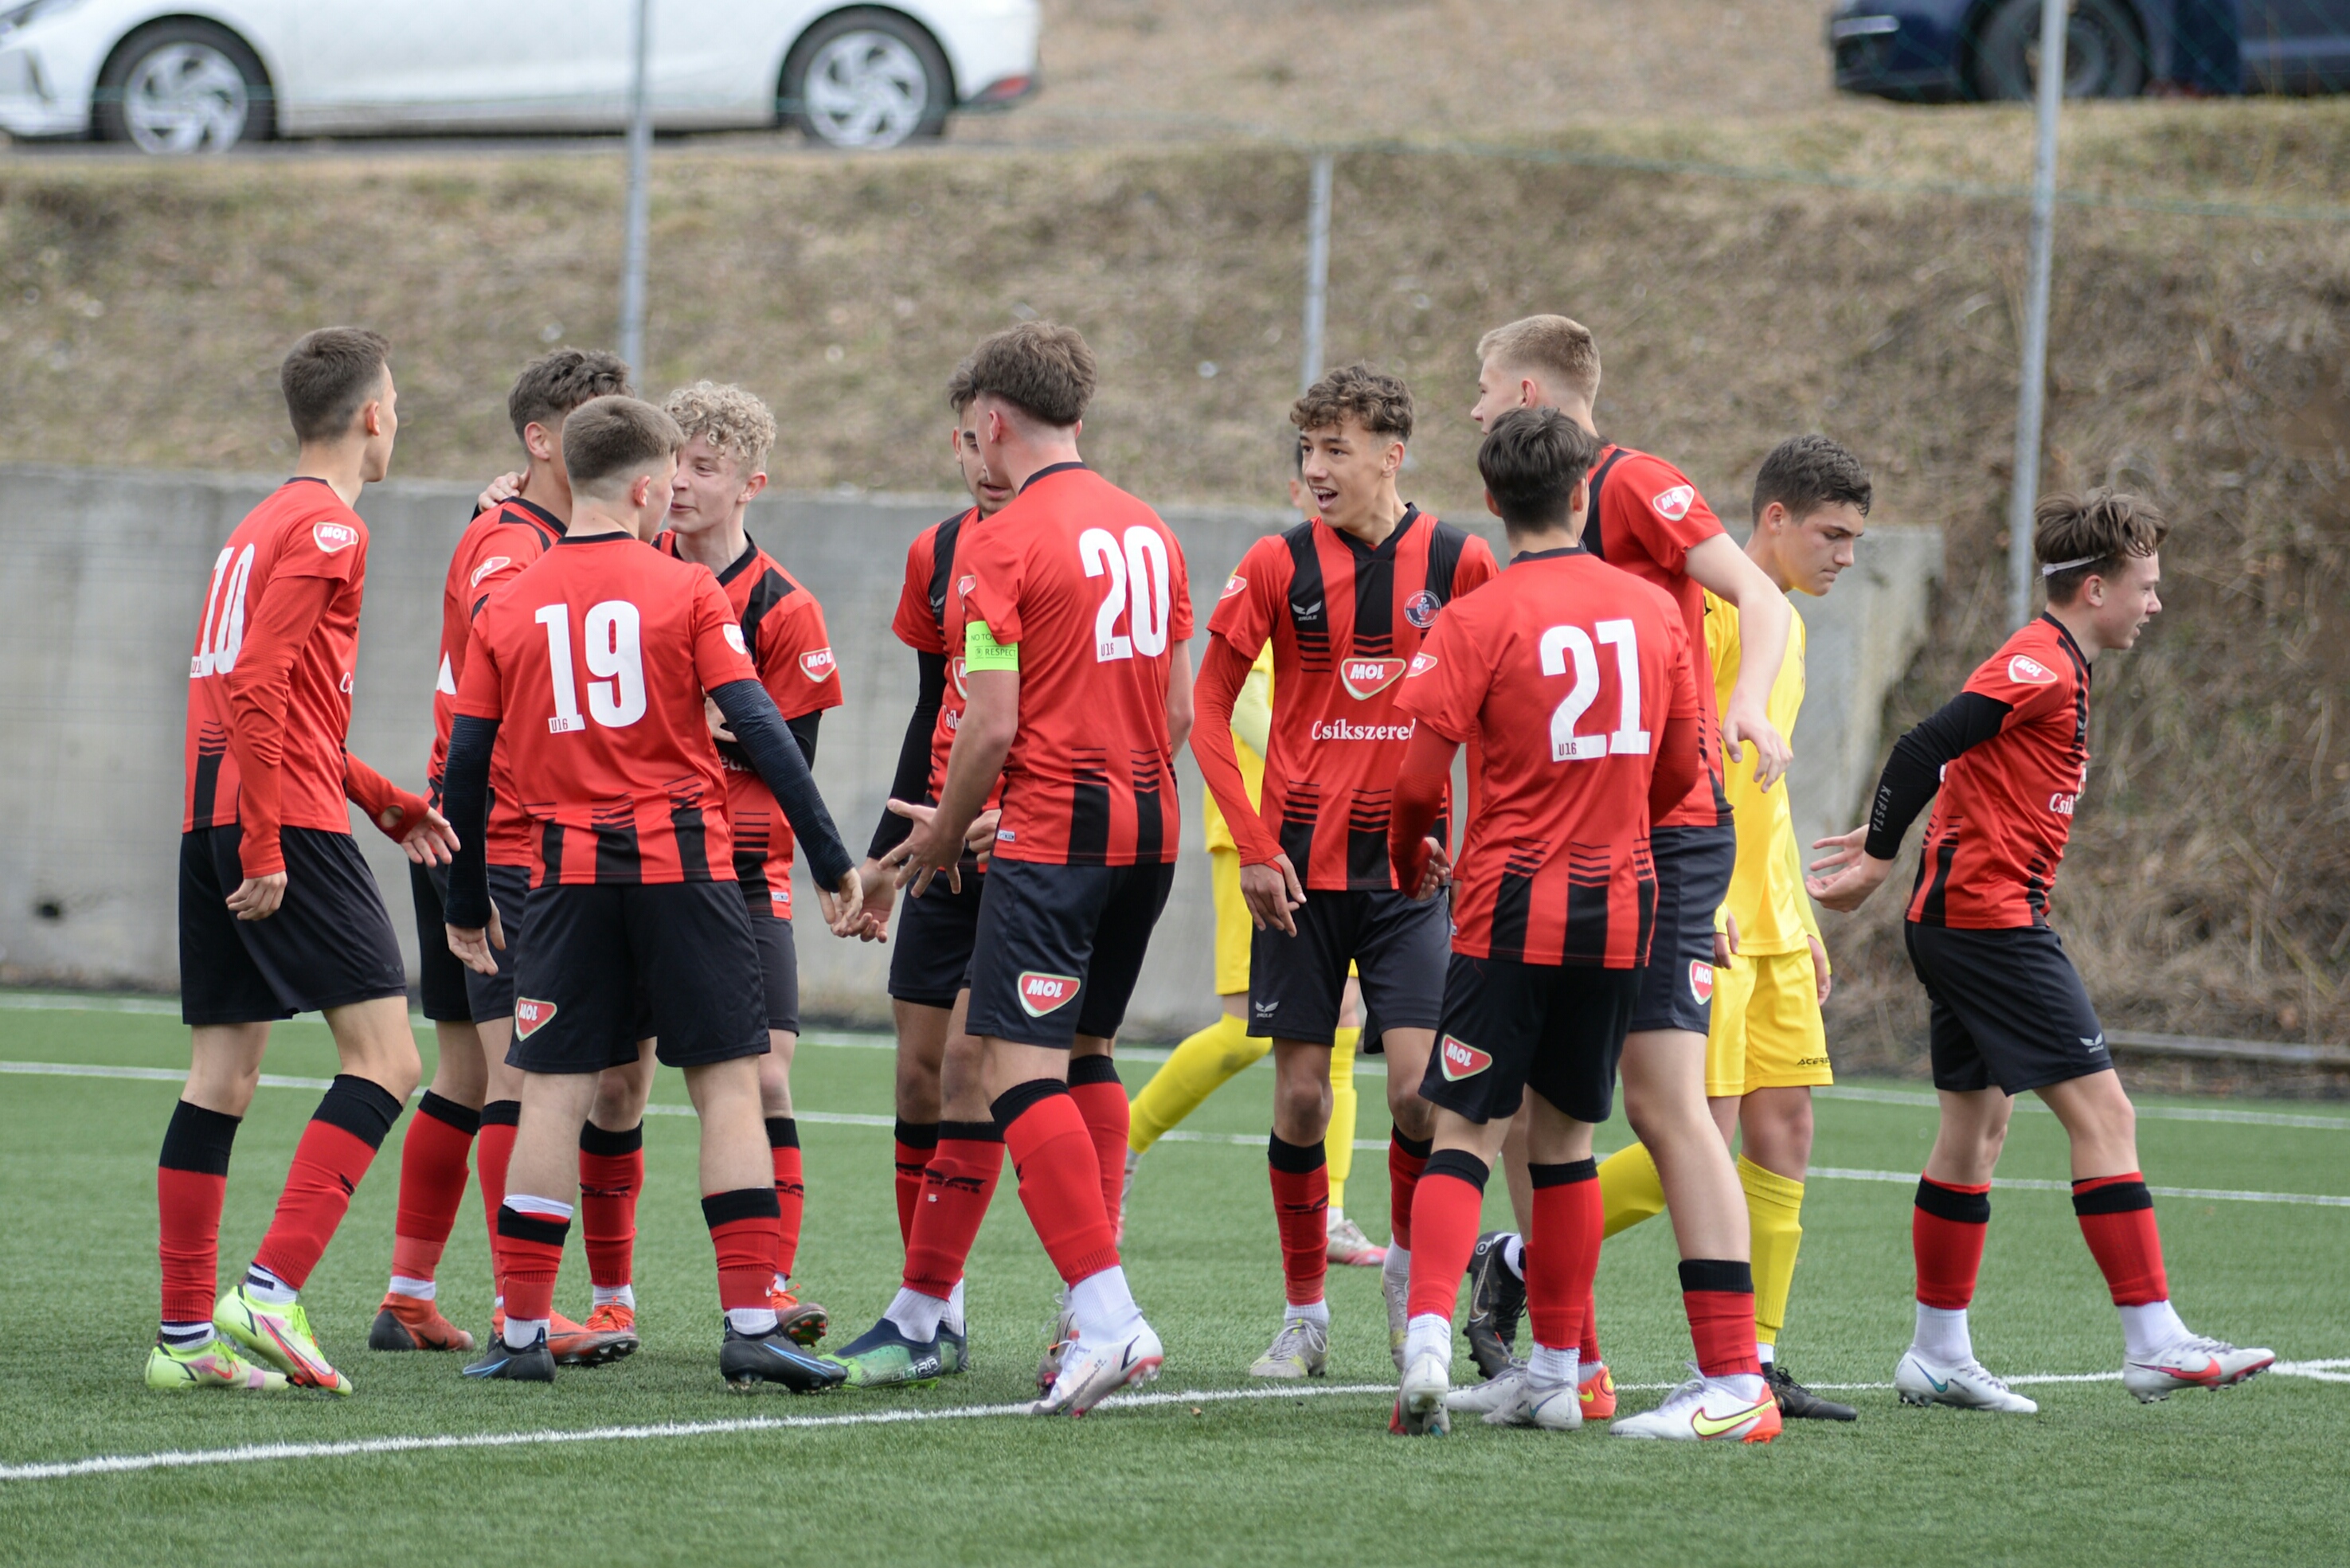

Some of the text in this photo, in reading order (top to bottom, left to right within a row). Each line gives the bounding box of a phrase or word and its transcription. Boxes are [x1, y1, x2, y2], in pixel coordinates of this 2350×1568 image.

[319, 526, 347, 541] MOL
[1079, 526, 1170, 663] 20
[190, 543, 255, 677] 10
[985, 647, 1015, 657] RESPECT
[1101, 643, 1115, 657] U16
[534, 600, 647, 734] 19
[807, 652, 832, 668] MOL
[2015, 659, 2043, 677] MOL
[1350, 664, 1384, 680] MOL
[1540, 619, 1651, 762] 21
[551, 718, 569, 732] U16
[1558, 742, 1577, 756] U16
[1872, 784, 1892, 832] KIPSTA
[1695, 966, 1712, 986] MOL
[1026, 979, 1063, 999] MOL
[518, 1003, 538, 1022] MOL
[1446, 1042, 1472, 1067] MOL
[891, 1357, 939, 1382] ULTRA
